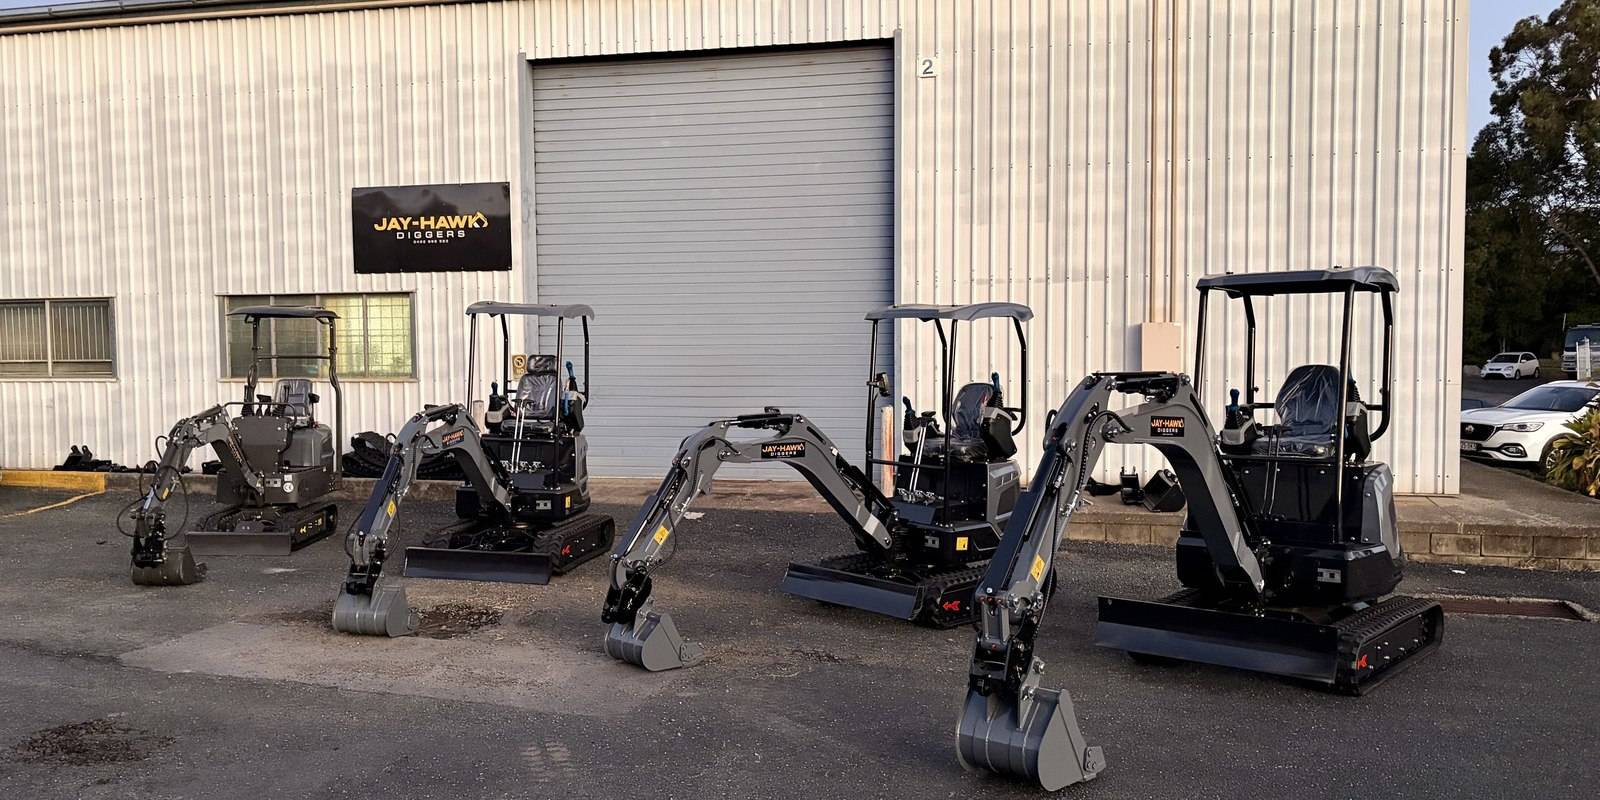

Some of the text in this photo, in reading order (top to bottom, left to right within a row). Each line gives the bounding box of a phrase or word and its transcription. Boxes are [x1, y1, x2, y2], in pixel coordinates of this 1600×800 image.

[922, 59, 934, 75] 2
[374, 212, 488, 231] JAY-HAWK
[396, 230, 466, 240] DIGGERS
[762, 443, 805, 453] JAY-HAWK
